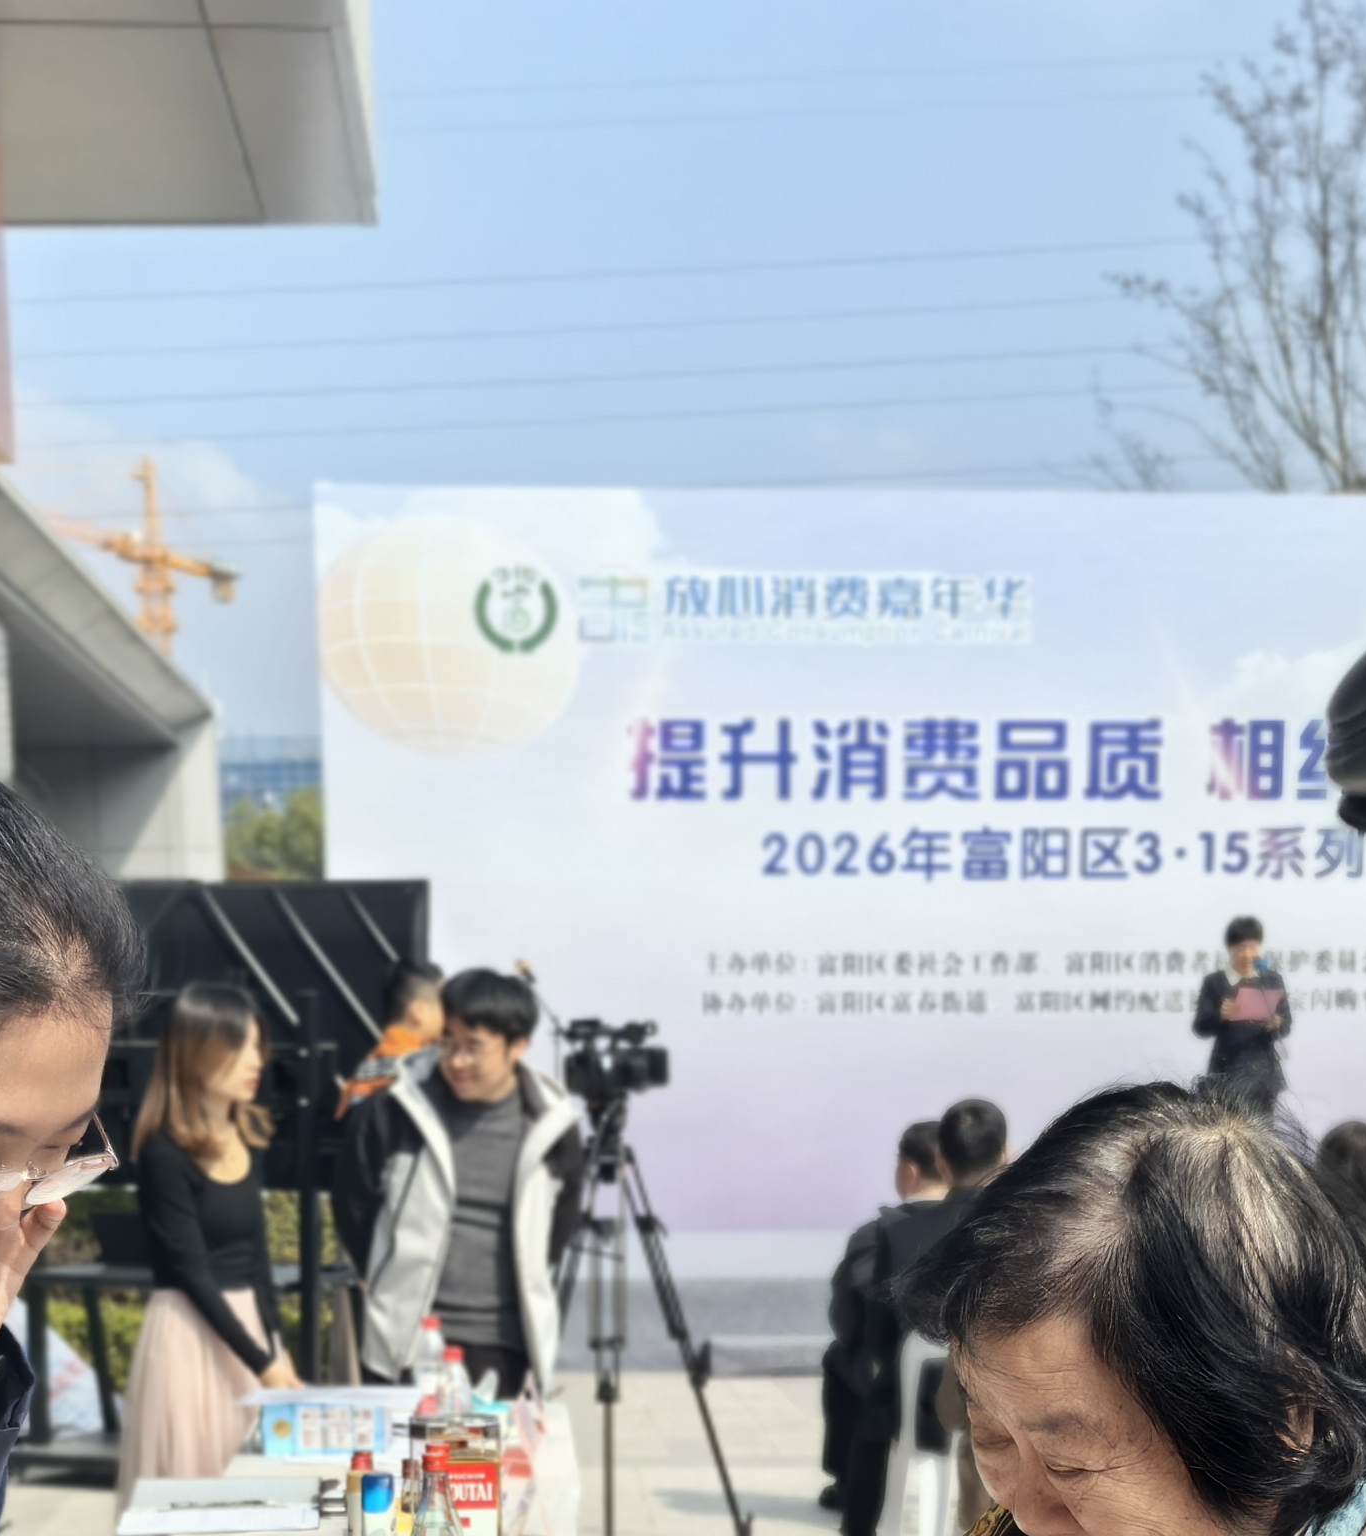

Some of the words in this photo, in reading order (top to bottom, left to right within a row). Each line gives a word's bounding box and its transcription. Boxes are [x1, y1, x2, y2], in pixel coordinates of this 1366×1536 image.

[663, 573, 1030, 620] 放心消费嘉年华
[627, 715, 1163, 803] 提升消费品质
